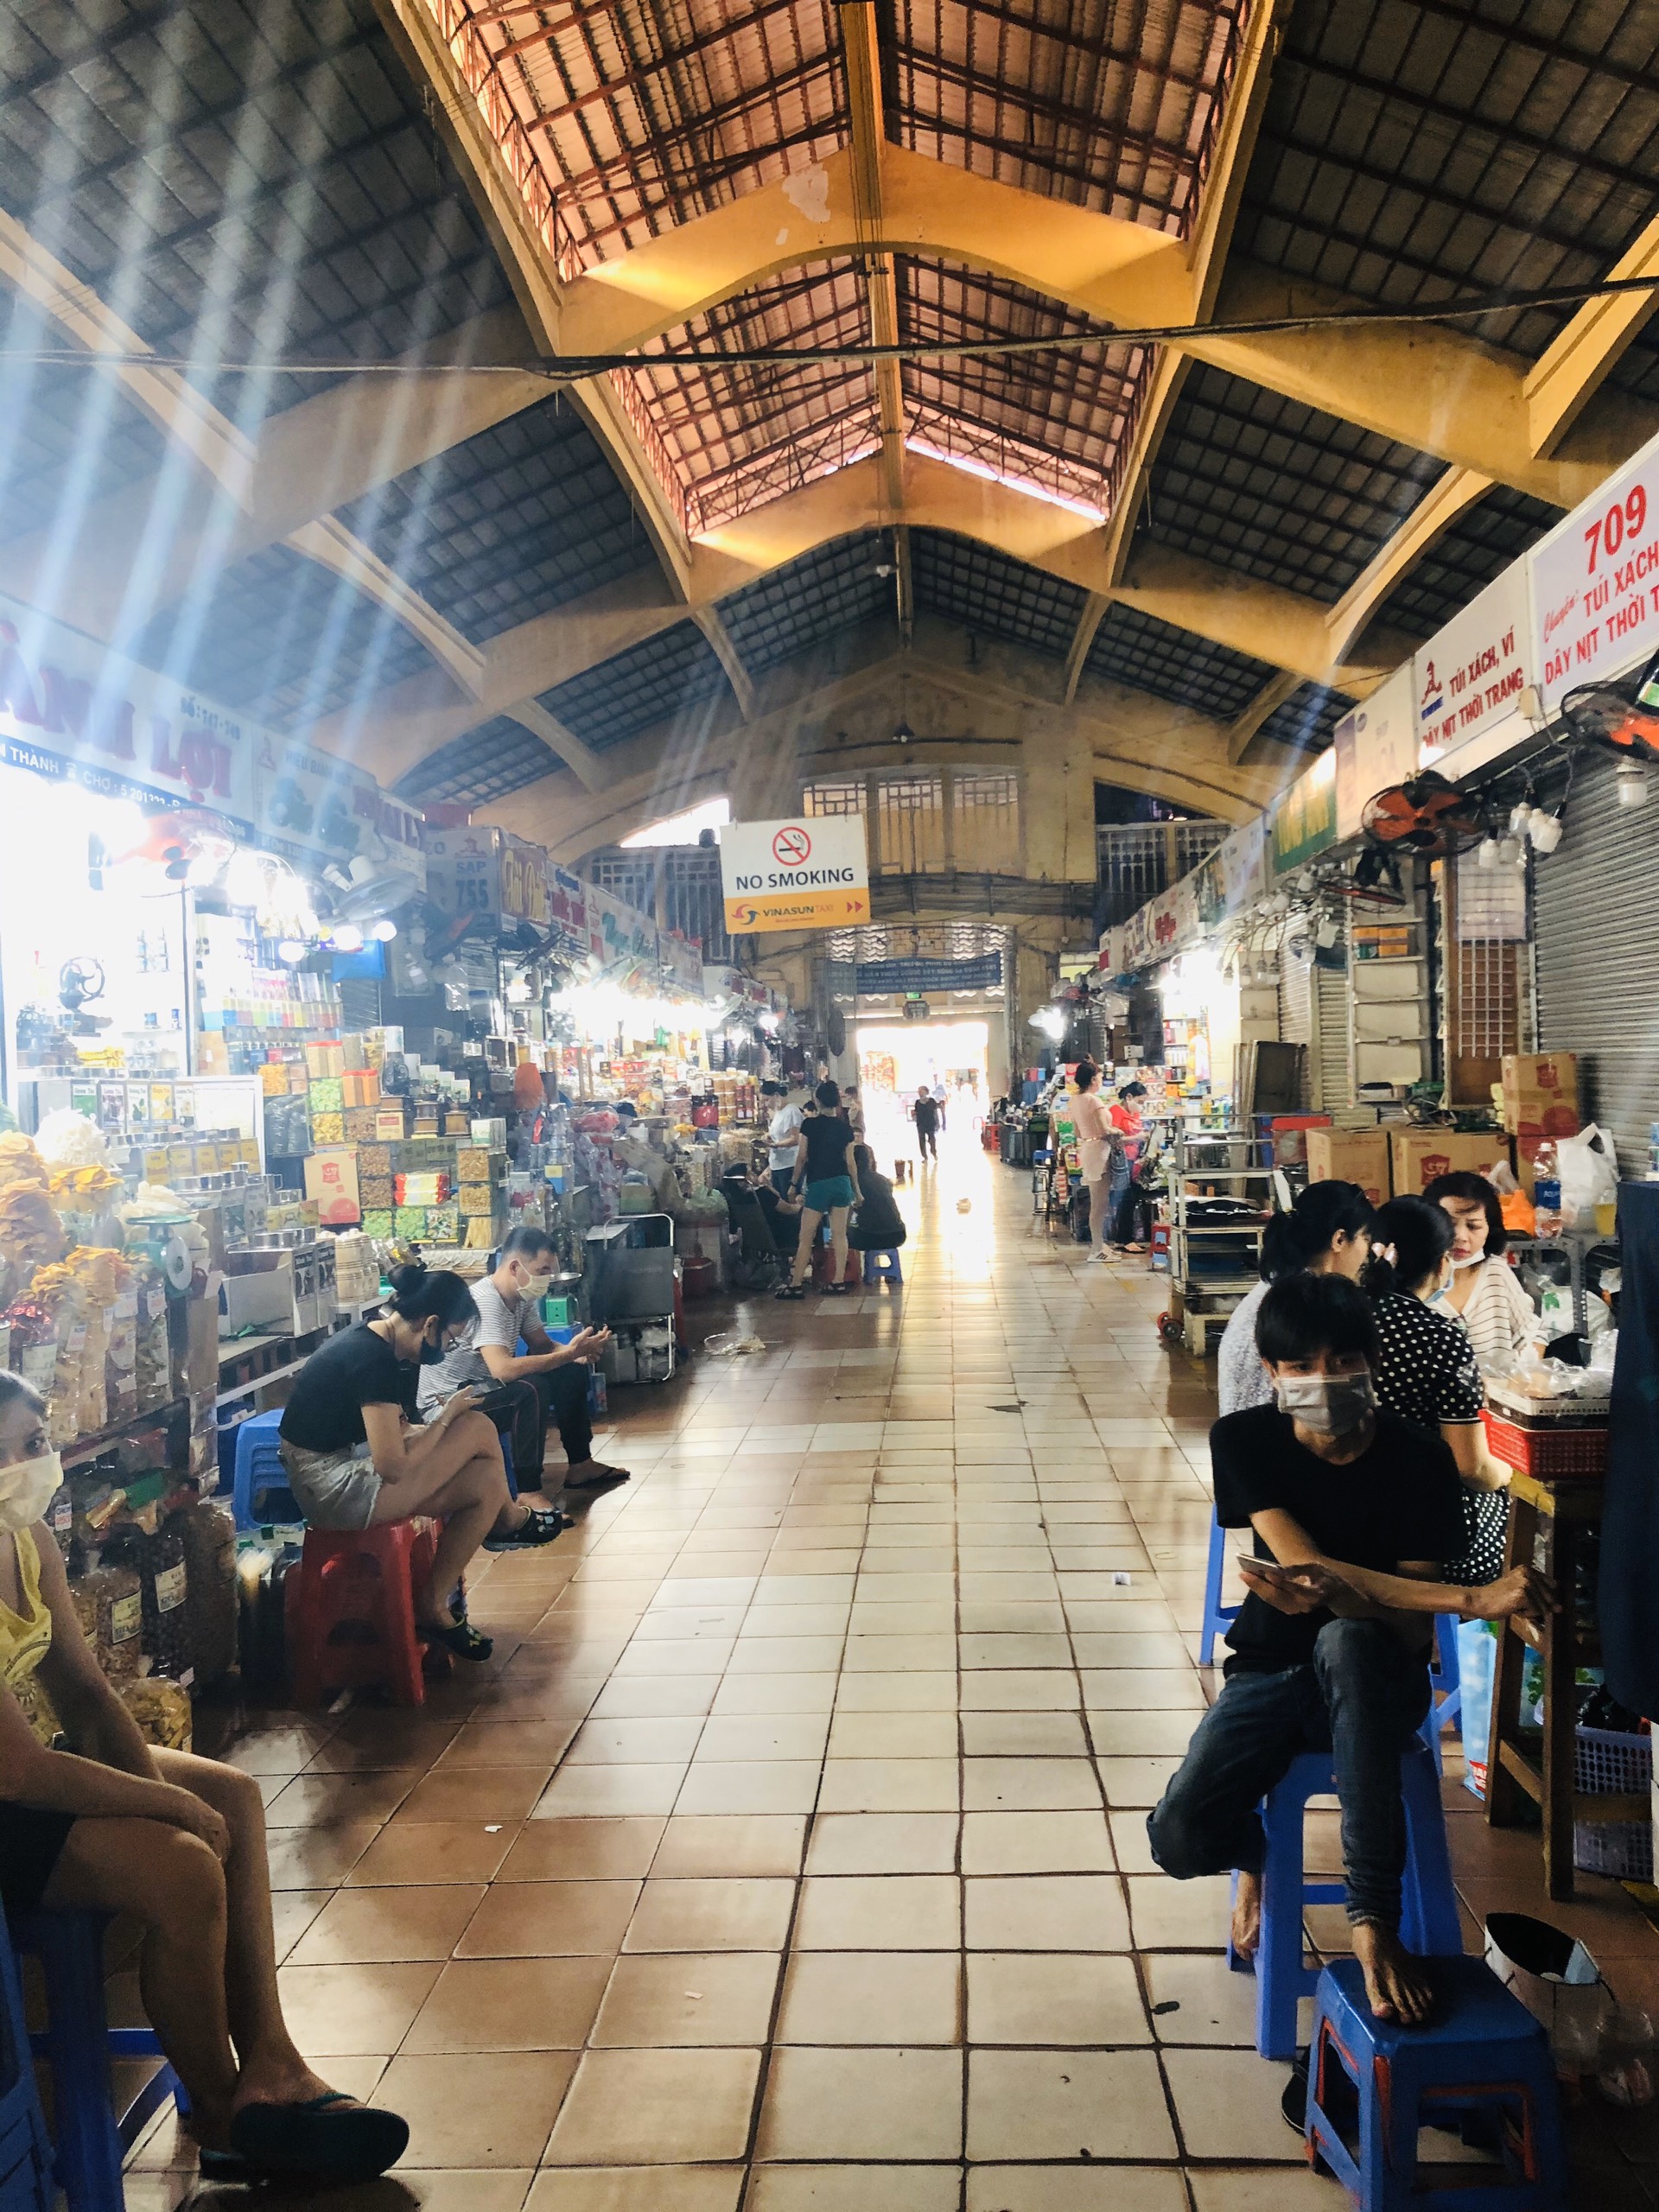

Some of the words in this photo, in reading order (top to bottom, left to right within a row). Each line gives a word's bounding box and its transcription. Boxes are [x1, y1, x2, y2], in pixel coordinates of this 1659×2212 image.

[1585, 484, 1647, 575] 709
[1583, 574, 1609, 618] TÚI
[1614, 540, 1659, 597] XÁCH
[1545, 648, 1572, 685] DÂY
[1576, 626, 1599, 663] NỊT
[1605, 593, 1645, 642] THỜI
[1449, 666, 1466, 697] TÚI
[1484, 667, 1524, 709] TRANG
[10, 746, 59, 774] THÀNH
[736, 874, 763, 890] NO
[768, 868, 854, 888] SMOKING
